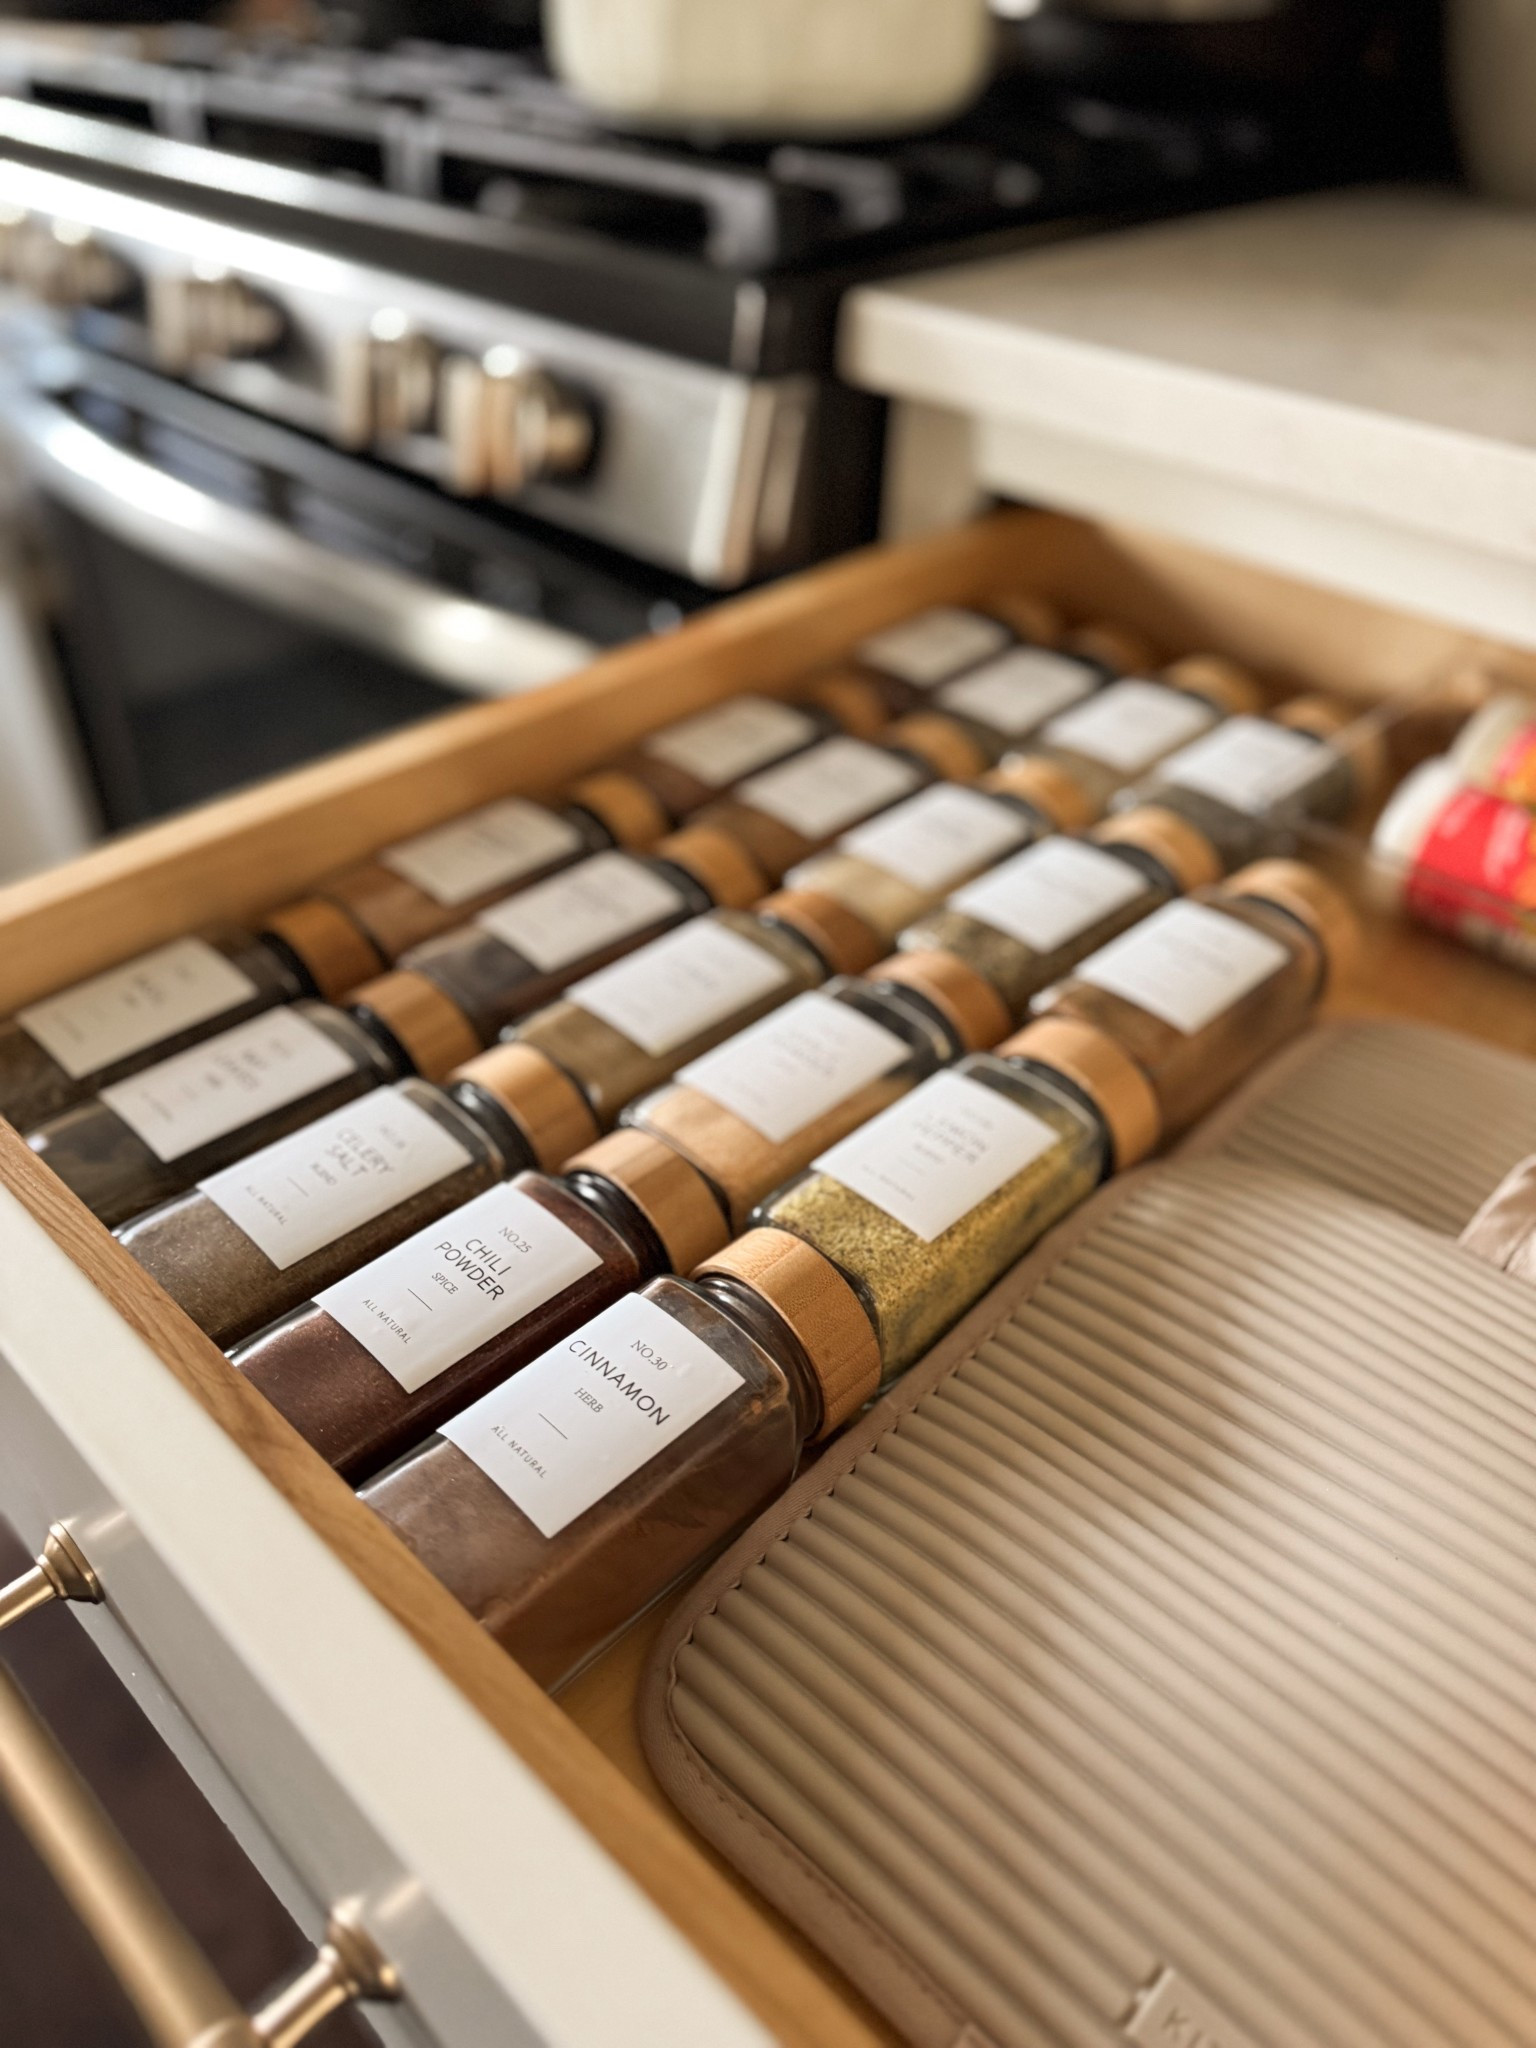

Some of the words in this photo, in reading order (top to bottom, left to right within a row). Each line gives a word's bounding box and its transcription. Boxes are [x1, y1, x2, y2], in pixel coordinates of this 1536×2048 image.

[325, 1144, 369, 1176] SALT
[337, 1128, 394, 1174] CELERY
[258, 1196, 288, 1226] NATURAL
[465, 1238, 511, 1276] CHILI
[498, 1226, 533, 1253] NO.25
[431, 1271, 459, 1295] SPICE
[434, 1241, 505, 1301] POWDER
[362, 1299, 376, 1312] ALL
[377, 1311, 413, 1344] NATURAL
[630, 1339, 668, 1371] NO.30
[568, 1340, 670, 1426] CINNAMON
[574, 1387, 604, 1414] HERB
[491, 1425, 507, 1442] ALL
[508, 1439, 549, 1479] NATURAL
